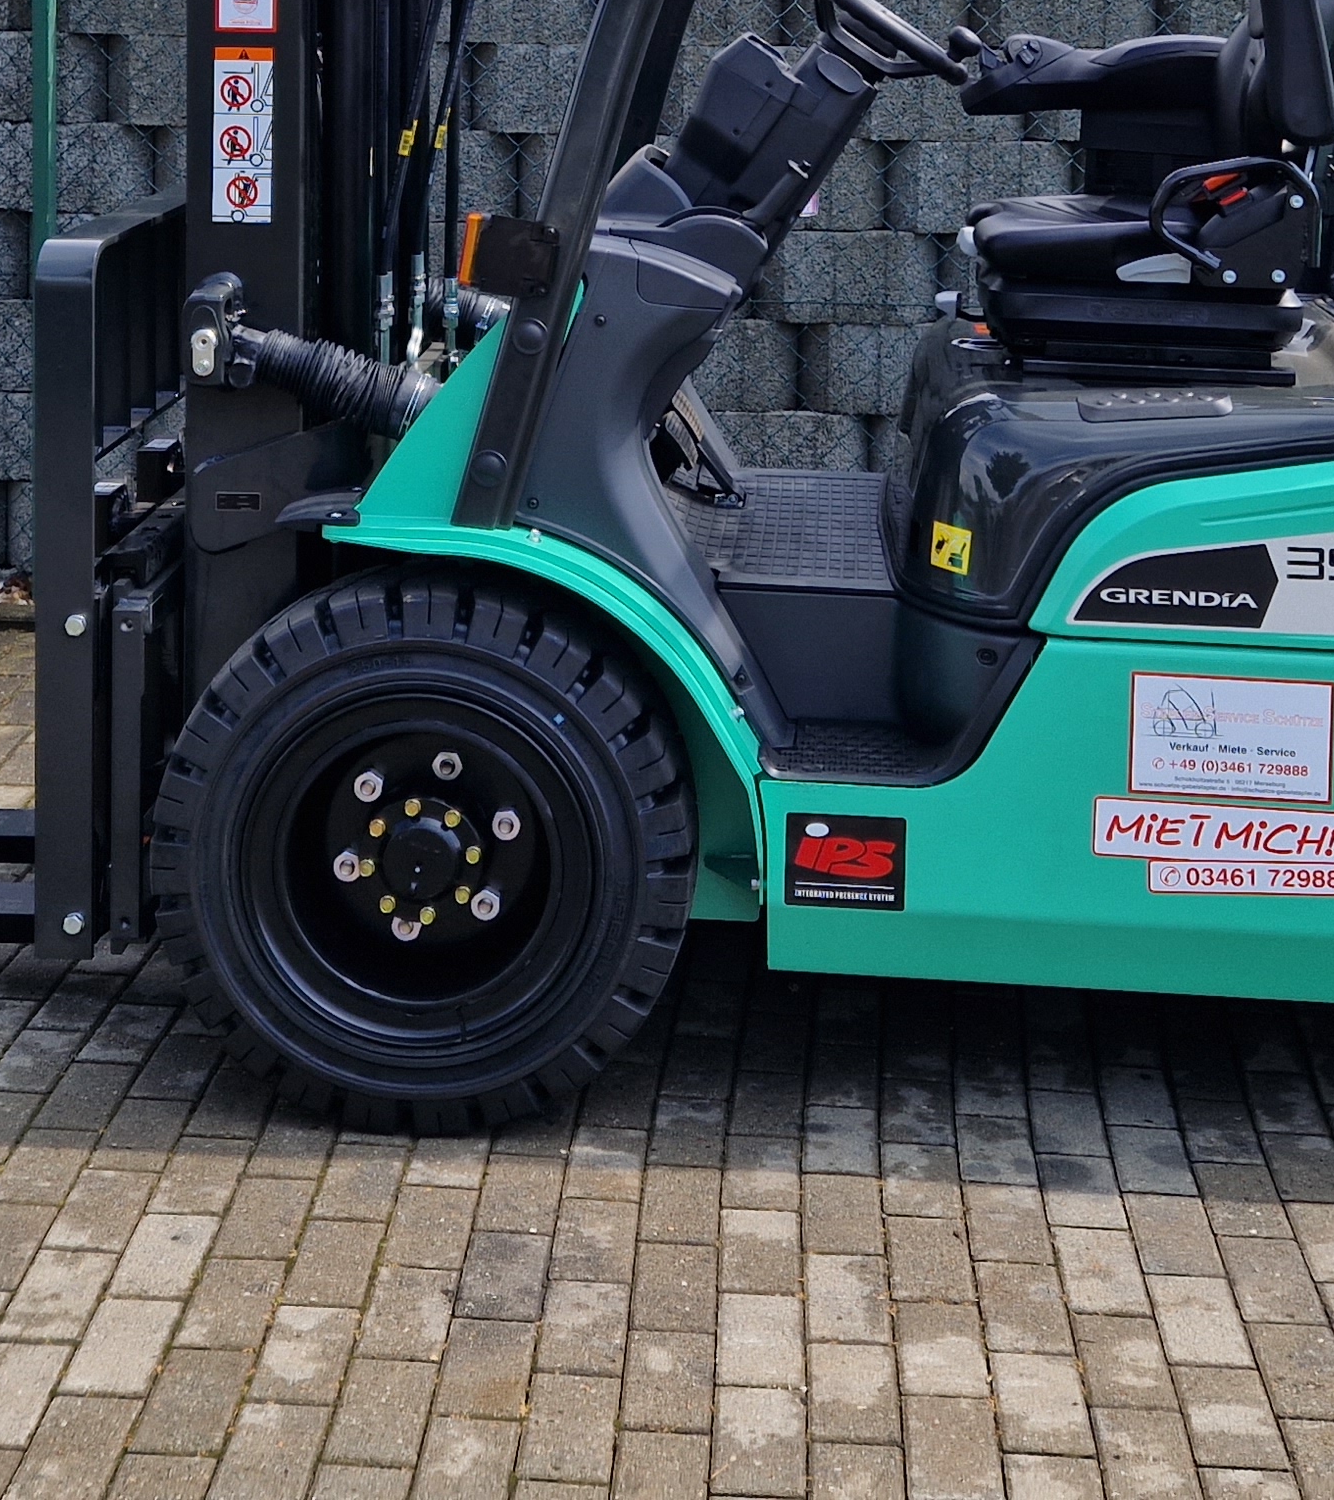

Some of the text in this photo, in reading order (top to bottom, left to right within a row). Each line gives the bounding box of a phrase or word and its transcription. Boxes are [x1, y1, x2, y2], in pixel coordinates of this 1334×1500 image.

[1169, 741, 1297, 758] Verkauf Miete Service
[1169, 759, 1309, 777] +49 (0)3461 729888
[1186, 867, 1257, 887] 03461
